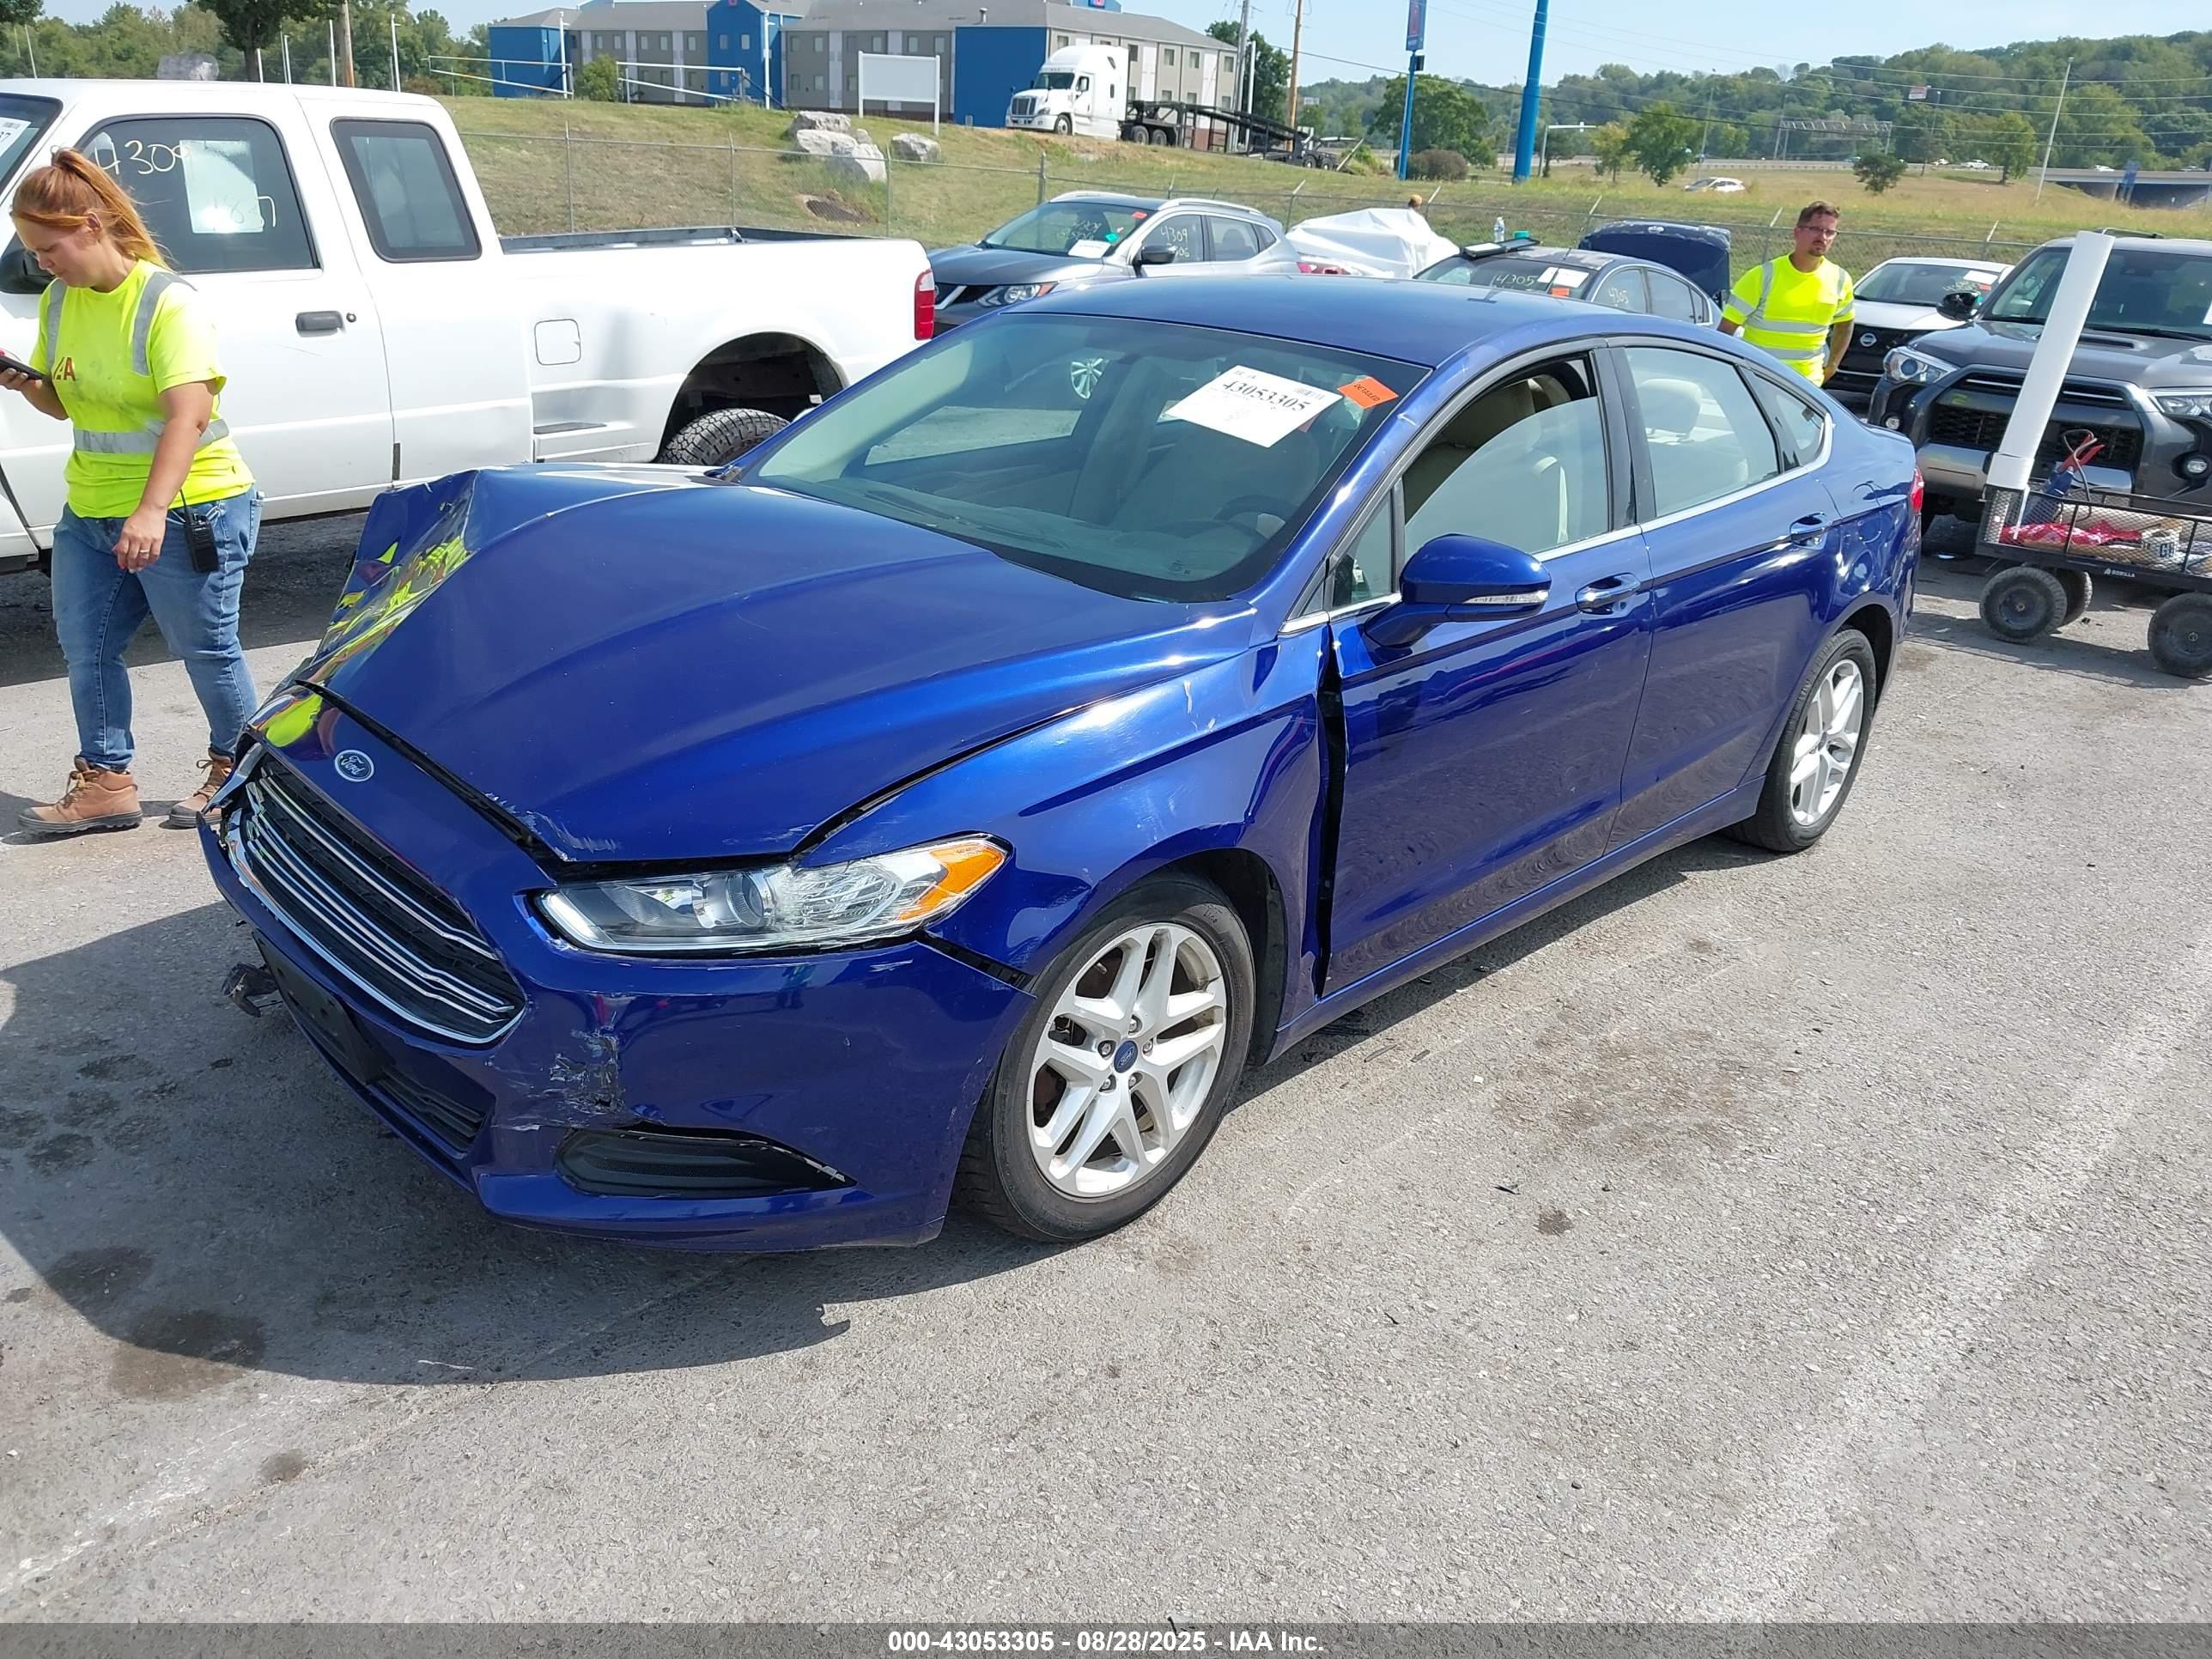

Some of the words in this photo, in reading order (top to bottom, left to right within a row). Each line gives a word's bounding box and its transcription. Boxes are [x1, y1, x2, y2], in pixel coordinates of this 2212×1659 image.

[1160, 225, 1188, 246] 4309
[1496, 274, 1539, 287] 4305
[1223, 380, 1312, 411] 43053305
[1353, 383, 1381, 402] DETAILED
[340, 755, 366, 775] Ford
